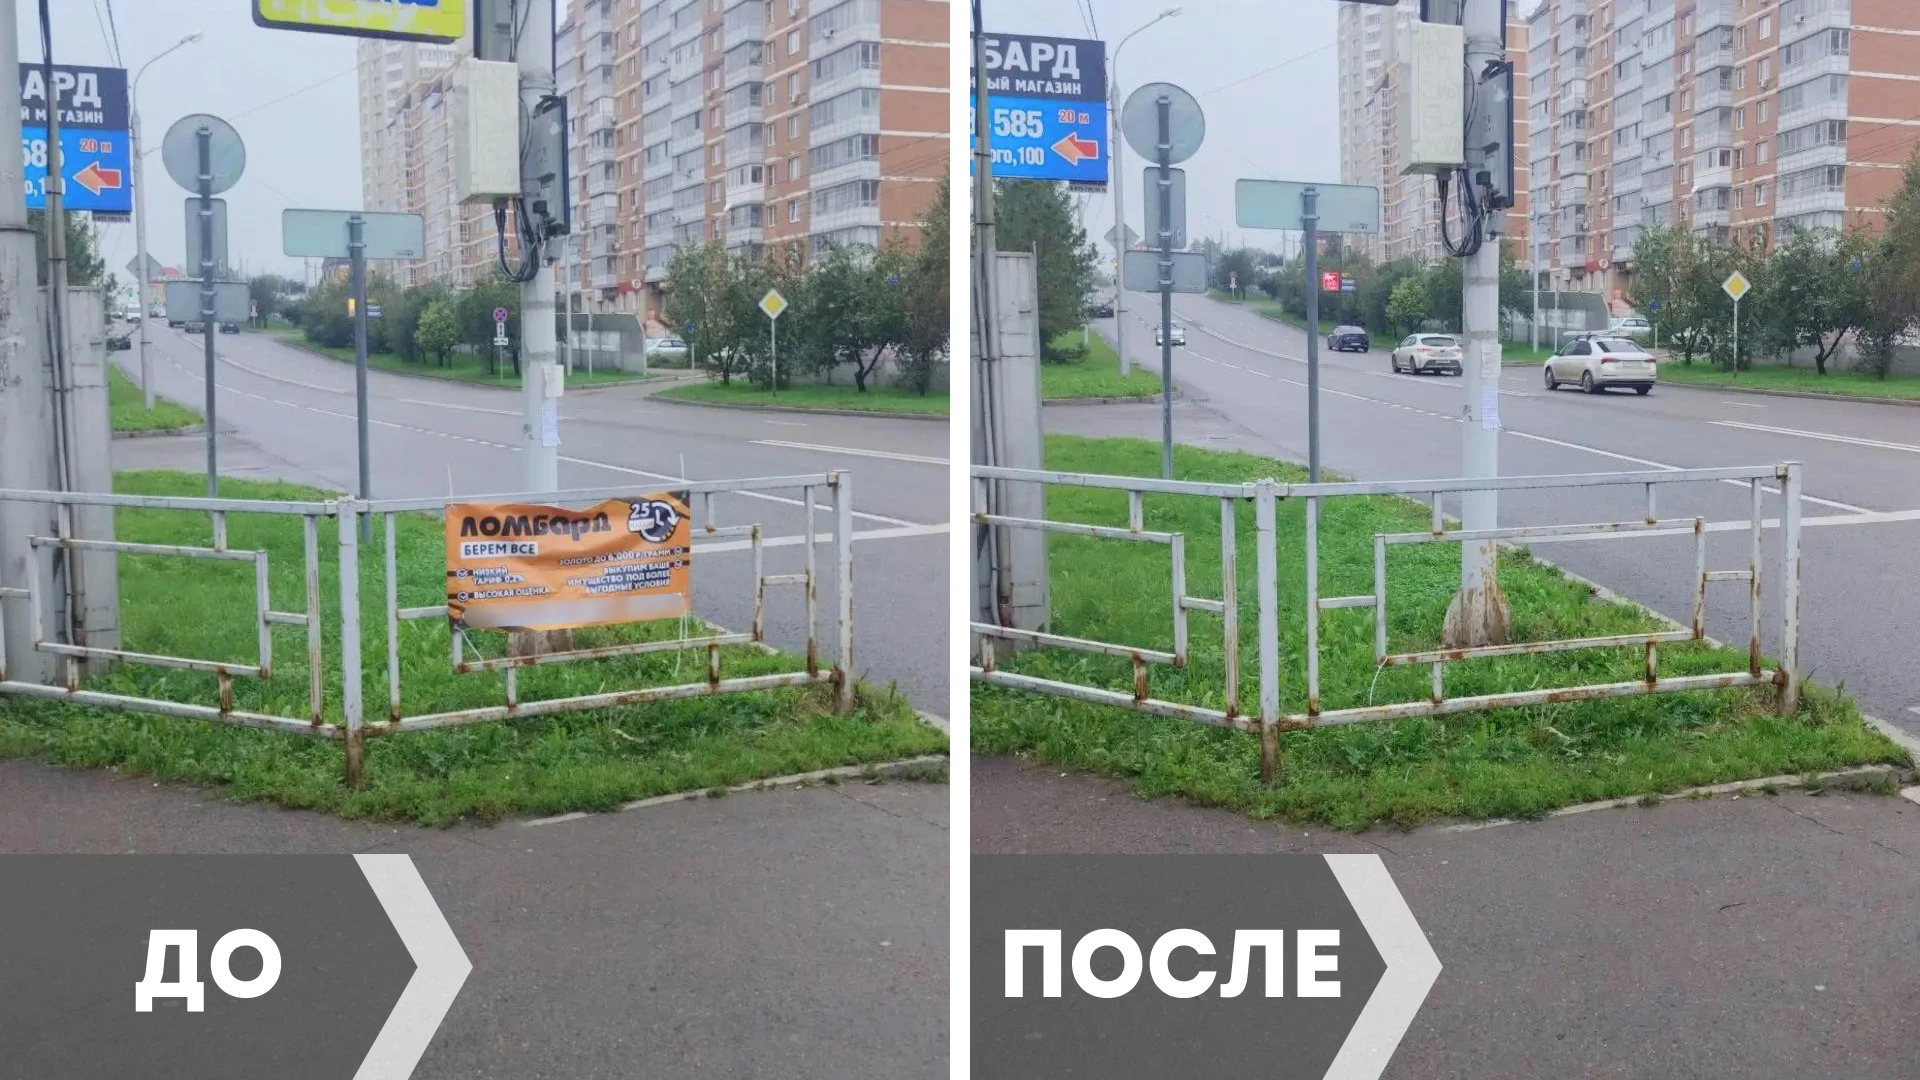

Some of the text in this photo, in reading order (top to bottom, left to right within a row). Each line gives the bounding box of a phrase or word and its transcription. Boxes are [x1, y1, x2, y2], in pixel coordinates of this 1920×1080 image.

[20, 69, 102, 109] АРД
[1015, 79, 1082, 95] МАГАЗИН
[35, 109, 104, 124] МГАЗИН
[1058, 109, 1075, 124] 20
[80, 138, 98, 153] 20
[630, 502, 651, 519] 25
[464, 543, 536, 556] БЕРЕМ ВСЕ
[559, 557, 595, 566] ЗОЛОТО
[595, 555, 607, 564] ДО
[603, 560, 671, 575] ВЫКУПИМ ВАШЕ
[473, 566, 508, 576] НИЗКИЙ
[474, 575, 503, 585] ТАРИФ
[568, 575, 624, 587] ИМУЩЕСТВО
[625, 571, 645, 582] ПОД
[473, 586, 550, 600] ВЫСОКАЯ ОЦЕНКА
